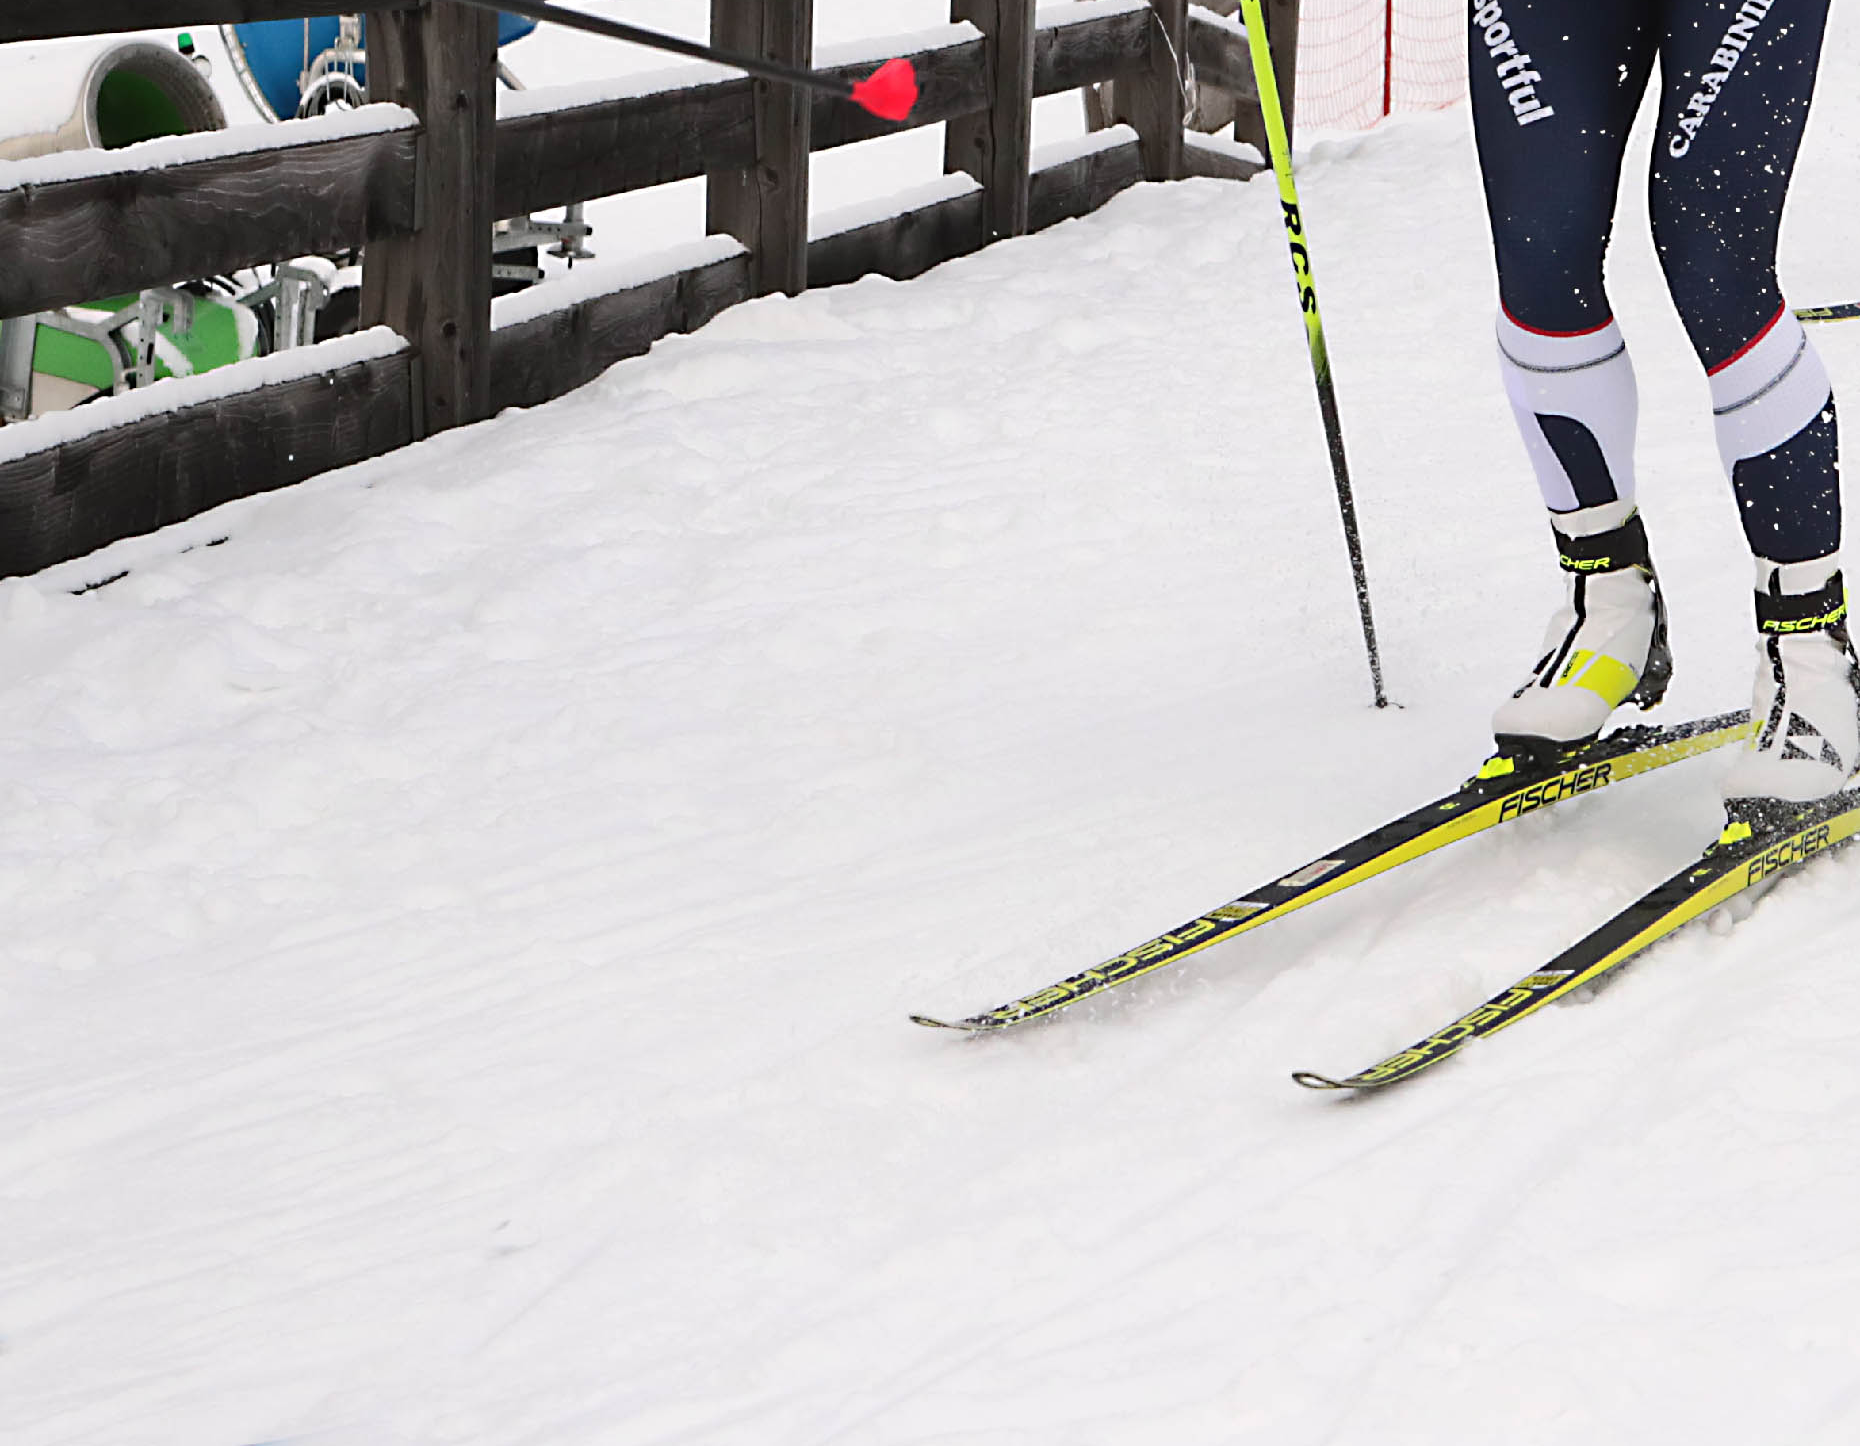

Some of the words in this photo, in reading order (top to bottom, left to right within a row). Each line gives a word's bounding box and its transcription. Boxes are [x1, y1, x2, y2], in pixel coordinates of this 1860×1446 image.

[1280, 198, 1317, 316] RCS
[1498, 761, 1613, 824] FISCHER
[1747, 824, 1831, 886] FISCHER
[988, 915, 1219, 1022] FISCHER
[1363, 986, 1537, 1083] FISCHER
